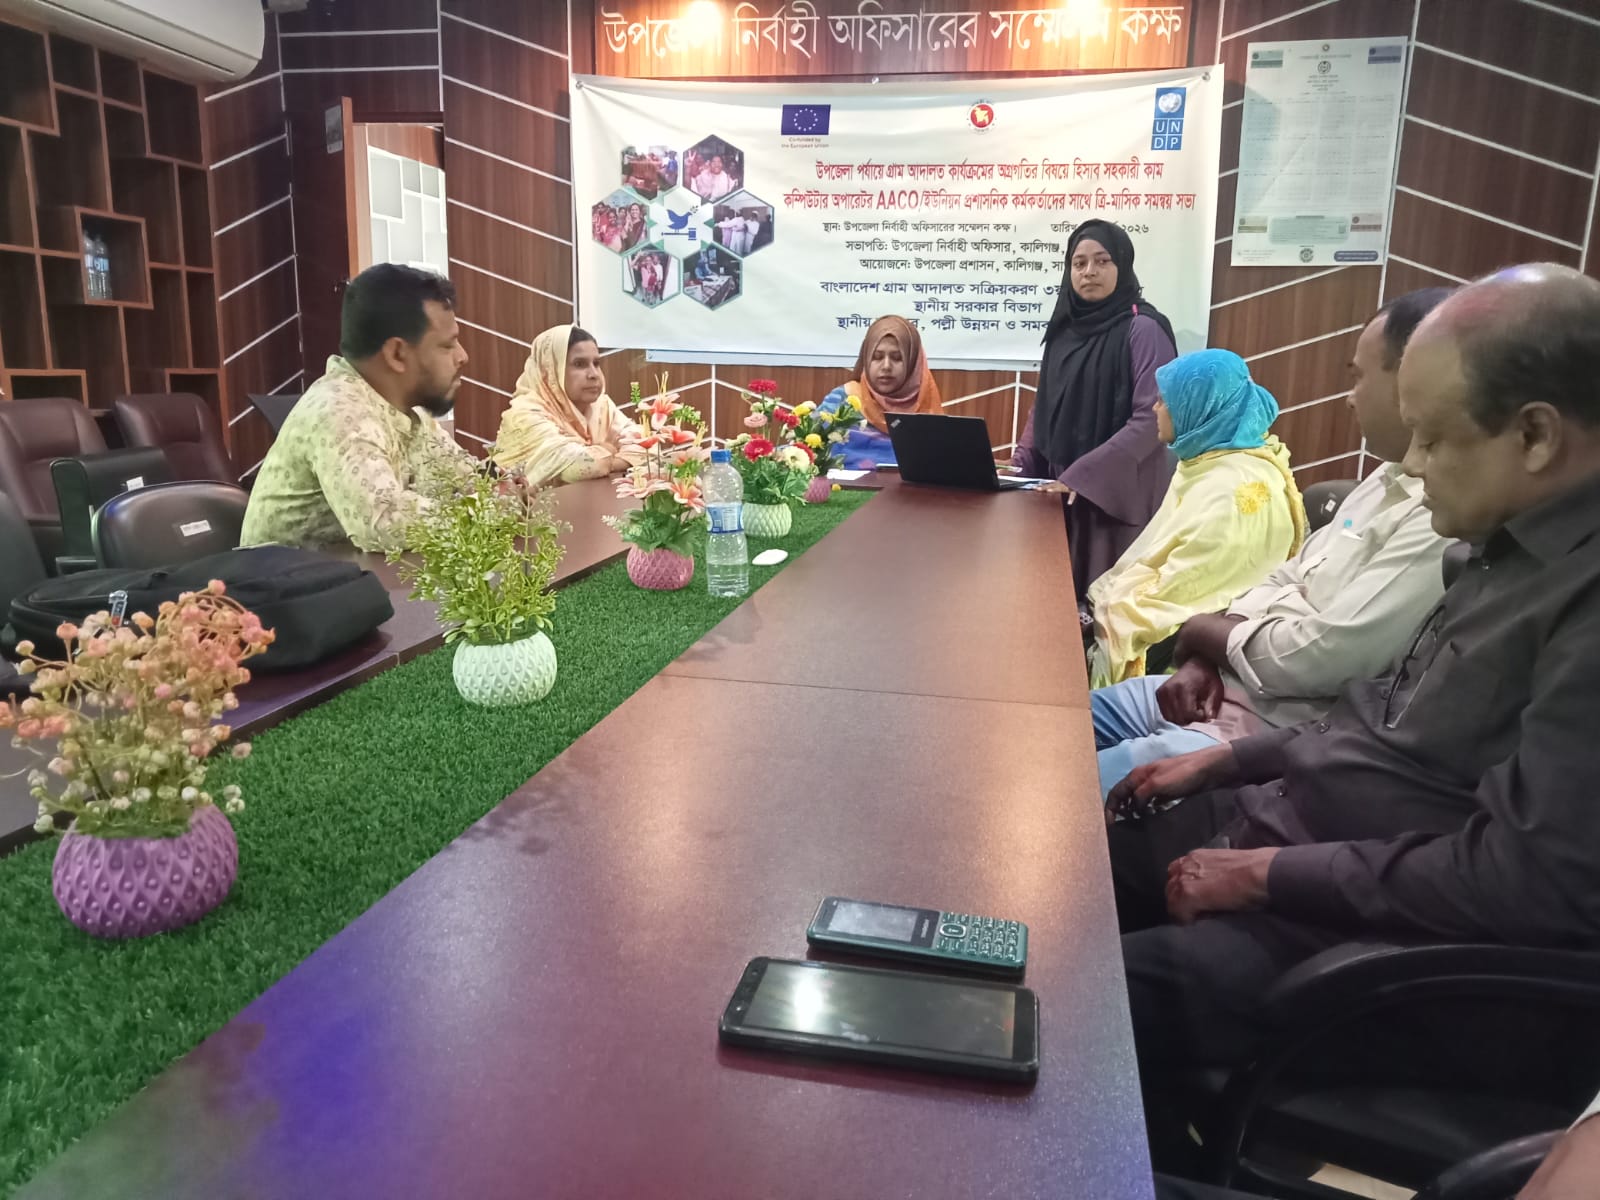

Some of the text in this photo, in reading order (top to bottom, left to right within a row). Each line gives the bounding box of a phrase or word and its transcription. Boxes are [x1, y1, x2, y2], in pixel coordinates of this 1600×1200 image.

[600, 6, 722, 57] উপজো
[731, 0, 821, 59] নির্বাহী
[827, 0, 981, 54] অফিসারের
[1118, 7, 1184, 45] কক্ষ
[816, 160, 853, 180] উপজেলা
[886, 163, 903, 180] গ্রাম
[908, 164, 944, 180] আদালত
[948, 158, 995, 180] কার্যক্রমের
[998, 159, 1038, 180] অগ্রগতির
[1073, 158, 1100, 179] হিসাব
[1104, 156, 1140, 179] সহকারী
[1144, 162, 1164, 179] কাম
[784, 188, 829, 210] কম্পিউটার
[832, 190, 873, 210] অপারেটর
[964, 188, 1009, 210] প্রশাসনিক
[1012, 188, 1066, 210] কর্মকর্তাদের
[1069, 193, 1092, 210] সাথে
[1176, 193, 1197, 210] সভা
[844, 221, 879, 232] উপজেলা
[882, 220, 907, 232] নির্বাহী
[911, 221, 954, 232] অফিসারের
[958, 223, 989, 232] সম্মেলন
[892, 239, 933, 252] উপজেলা
[937, 239, 967, 252] নির্বাহী
[915, 257, 956, 270] উপজেলা
[820, 281, 879, 293] বাংলাদেশ
[883, 283, 908, 294] গ্রাম
[912, 283, 966, 294] আদালত
[954, 301, 998, 312] সরকার
[1003, 299, 1042, 313] বিভাগ
[1005, 321, 1016, 330] ও
